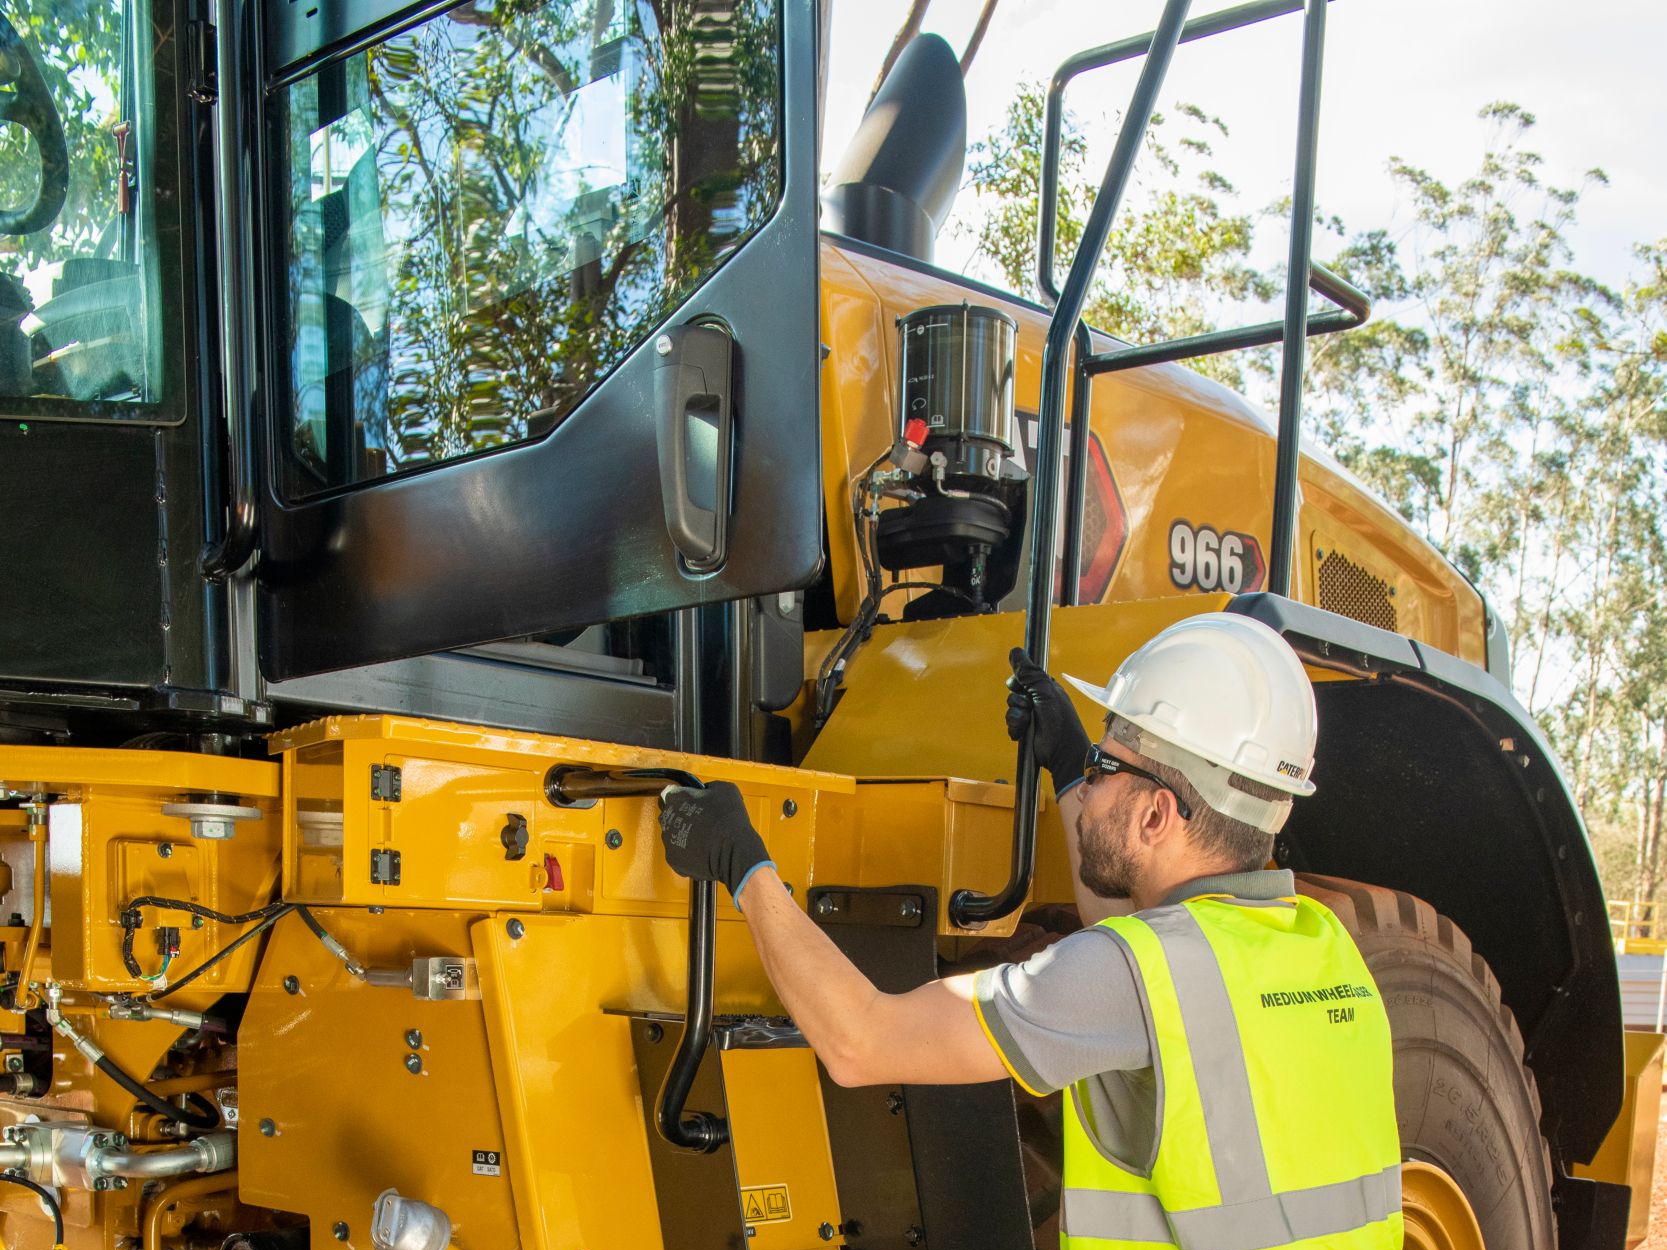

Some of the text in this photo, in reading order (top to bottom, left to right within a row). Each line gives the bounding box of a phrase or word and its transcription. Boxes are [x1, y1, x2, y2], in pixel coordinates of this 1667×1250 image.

[1170, 522, 1244, 593] 966
[1260, 991, 1317, 1008] MEDIUM
[1327, 1007, 1355, 1024] TEAM
